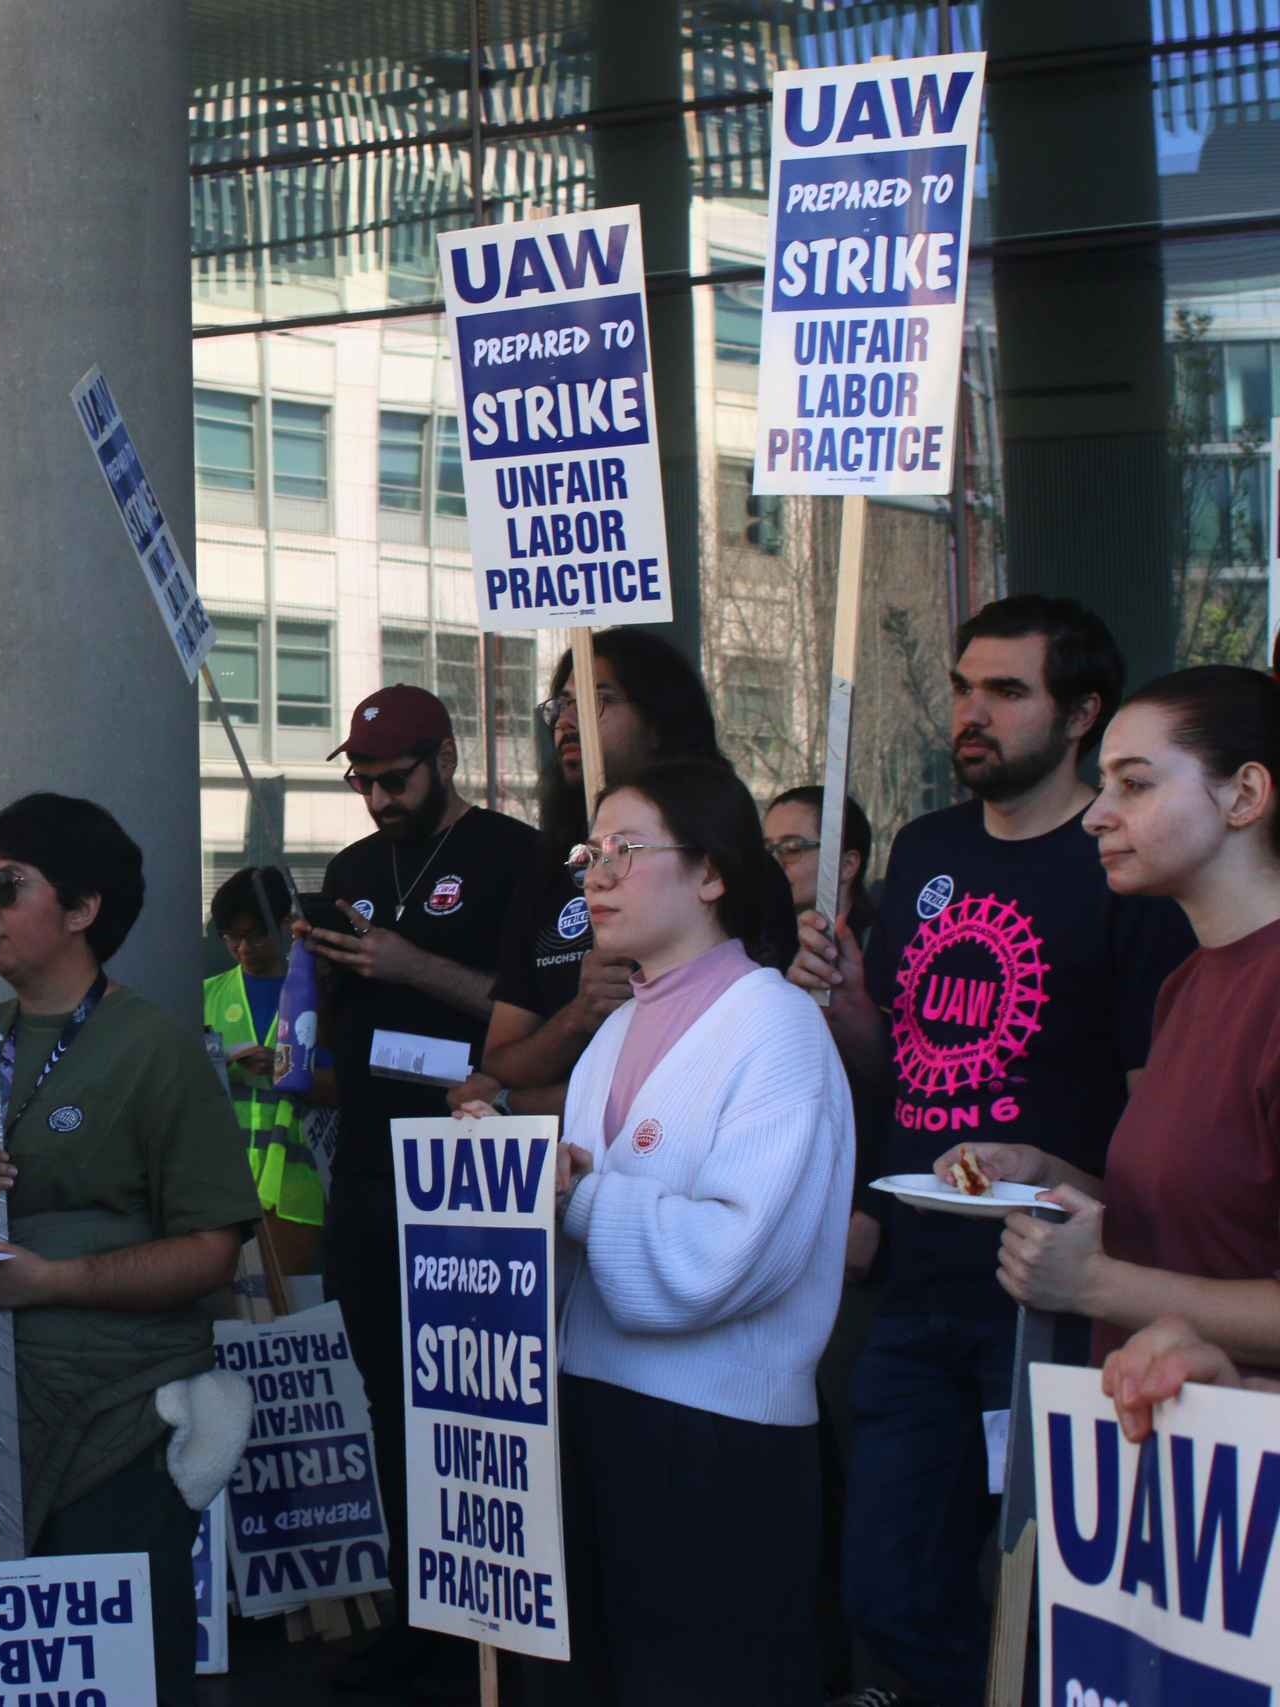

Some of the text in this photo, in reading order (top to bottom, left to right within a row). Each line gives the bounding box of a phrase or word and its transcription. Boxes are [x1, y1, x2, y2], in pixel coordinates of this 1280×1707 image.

[784, 71, 975, 147] UAW
[786, 173, 954, 213] PREPARED TO
[451, 223, 630, 304] UAW
[779, 232, 955, 297] STRIKE
[473, 319, 635, 367] PREPARED TO
[794, 317, 929, 365] UNFAIR
[78, 375, 117, 441] UAW
[472, 377, 641, 446] STRIKE
[797, 372, 919, 418] LABOR
[767, 425, 944, 472] PRACTICE
[496, 457, 628, 510] UNFAIR
[123, 478, 159, 543] STRIKE
[507, 509, 627, 559] LABOR
[486, 557, 661, 610] PRACTICE
[939, 931, 955, 943] AND
[922, 974, 996, 1028] UAW
[895, 1096, 1021, 1132] EGION 6
[402, 1138, 549, 1213] UAW
[413, 1254, 537, 1297] PREPARED TO
[214, 1331, 349, 1372] PRACTICE
[416, 1322, 543, 1406] STRIKE
[250, 1401, 345, 1440] UNFAI
[232, 1443, 367, 1495] STRIKE
[433, 1422, 529, 1492] UNFAIR
[241, 1500, 372, 1535] PREPARED TO
[440, 1487, 526, 1558] LABOR
[1047, 1411, 1280, 1639] UAW
[245, 1539, 389, 1598] UAW
[419, 1547, 556, 1630] PRACTICE
